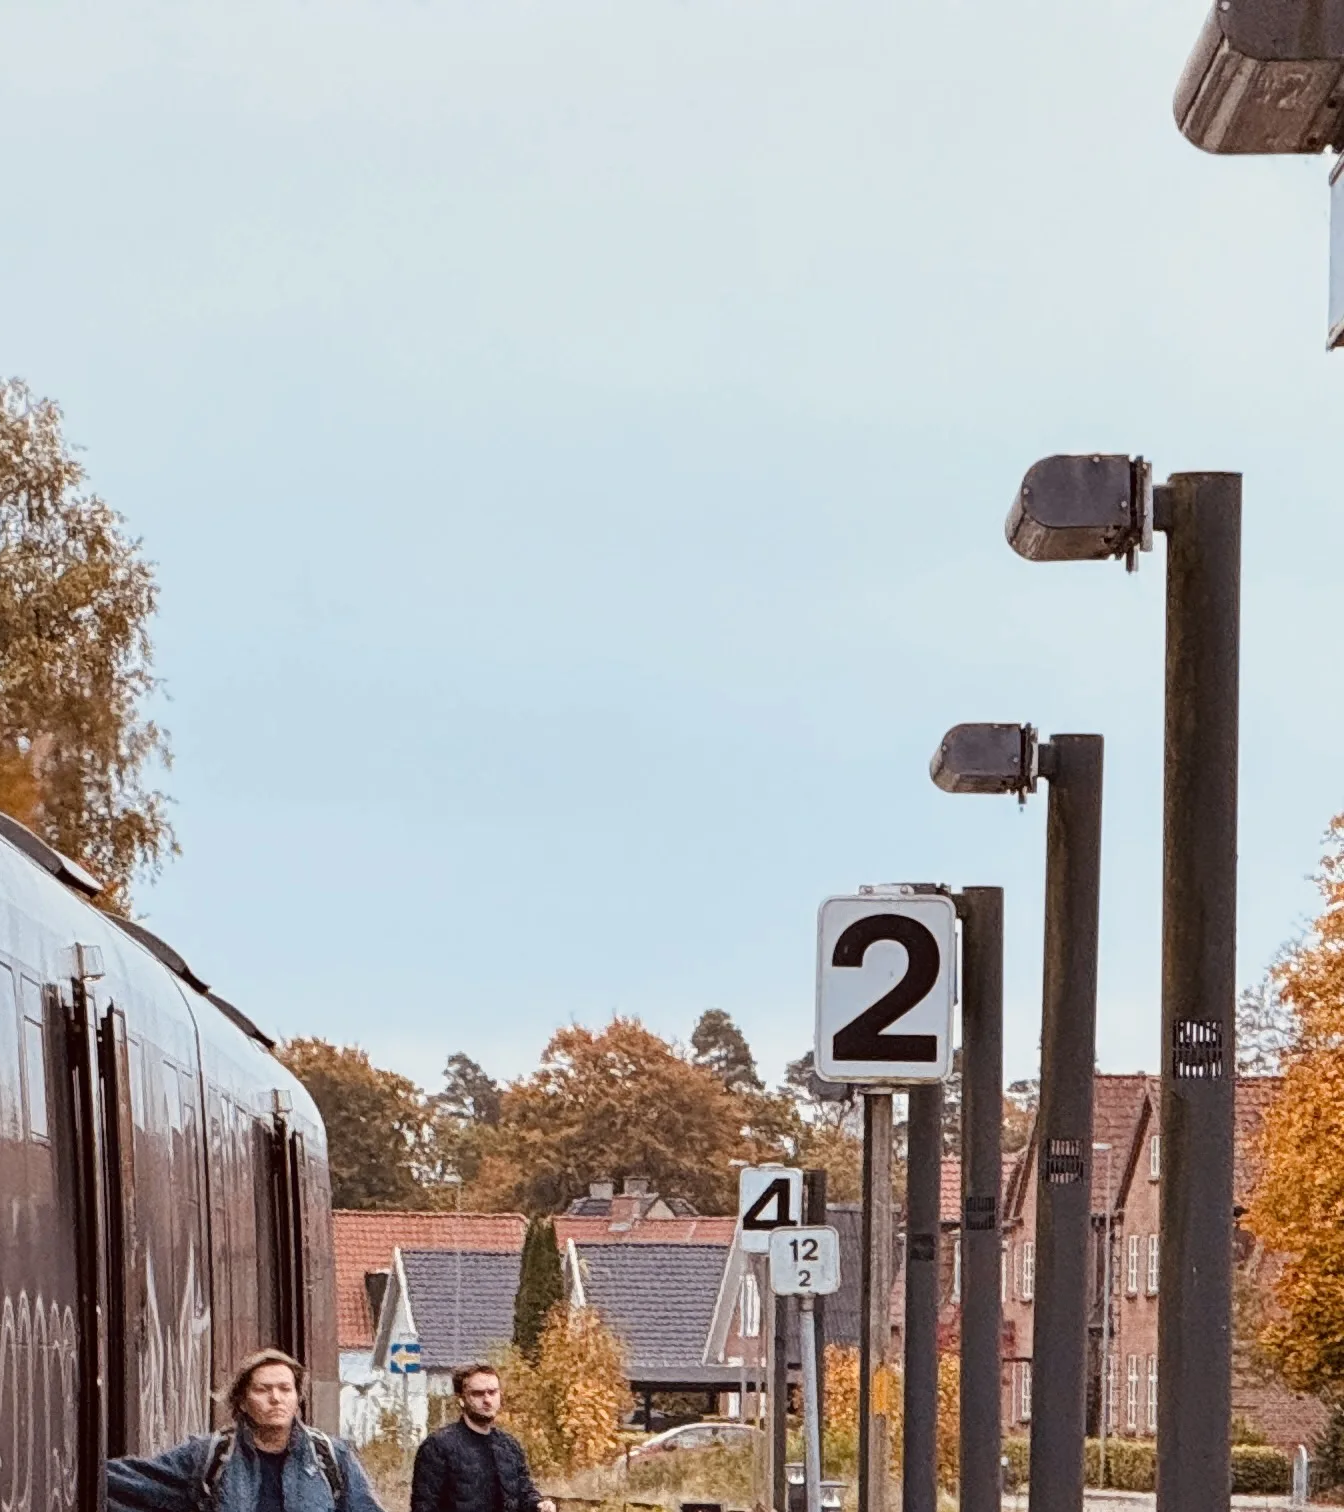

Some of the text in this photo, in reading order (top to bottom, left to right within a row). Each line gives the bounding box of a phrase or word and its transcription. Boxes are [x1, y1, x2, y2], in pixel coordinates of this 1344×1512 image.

[831, 913, 941, 1062] 2
[743, 1178, 798, 1231] 4
[789, 1238, 819, 1263] 12
[798, 1269, 811, 1287] 2
